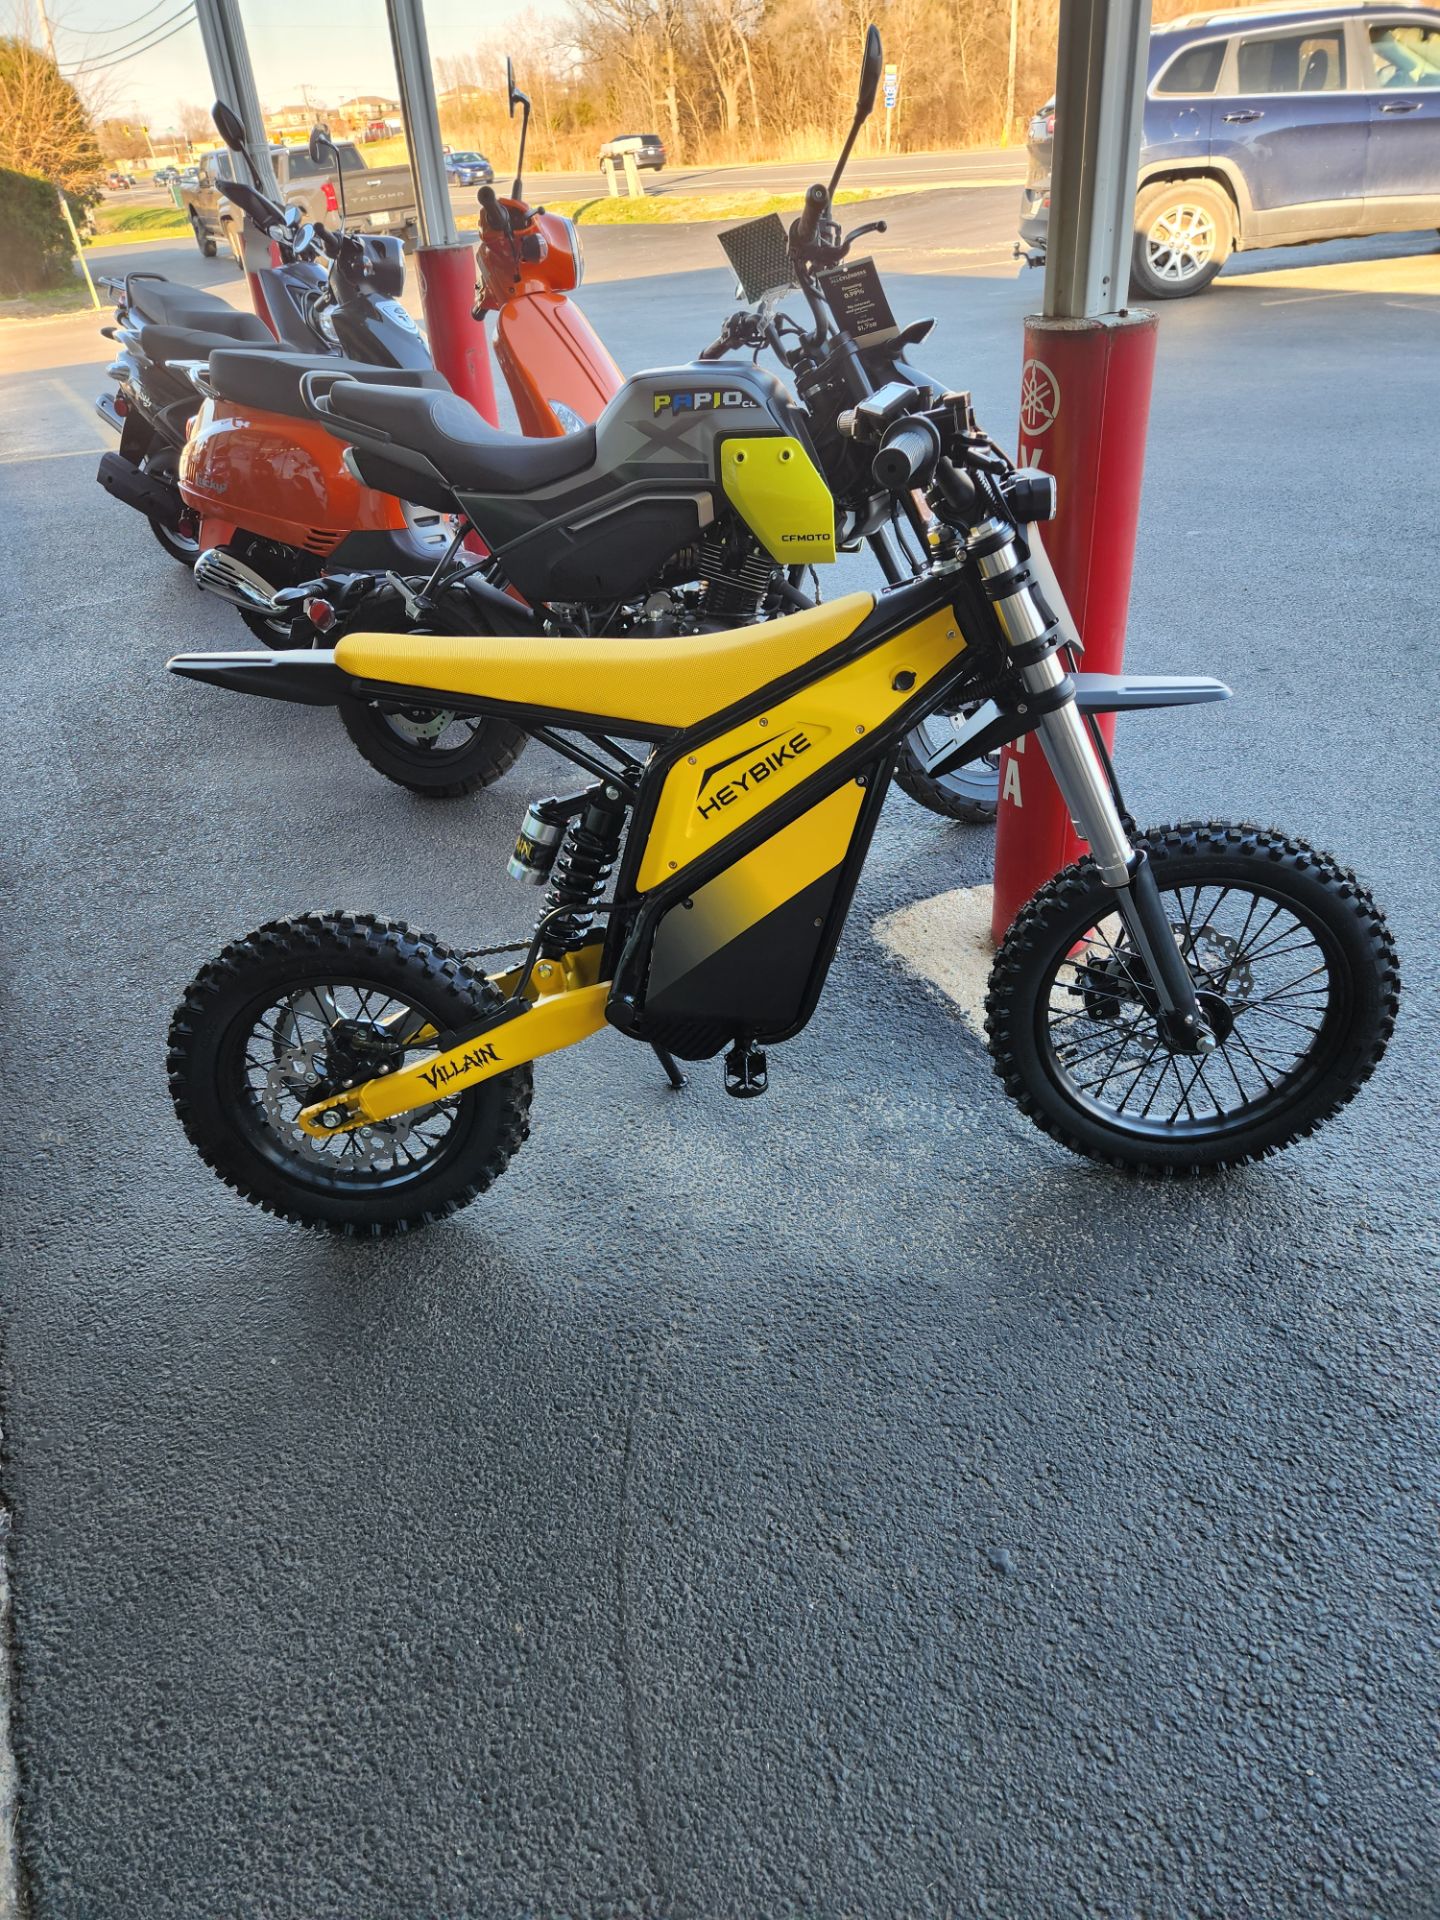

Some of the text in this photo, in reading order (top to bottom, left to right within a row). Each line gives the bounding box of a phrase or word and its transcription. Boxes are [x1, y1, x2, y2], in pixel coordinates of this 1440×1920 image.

[351, 191, 405, 203] TACOMA
[654, 391, 742, 415] PAPIO
[781, 533, 831, 542] CFMOTO
[697, 732, 812, 820] HEYBIKE
[416, 1043, 504, 1091] VILLAIN
